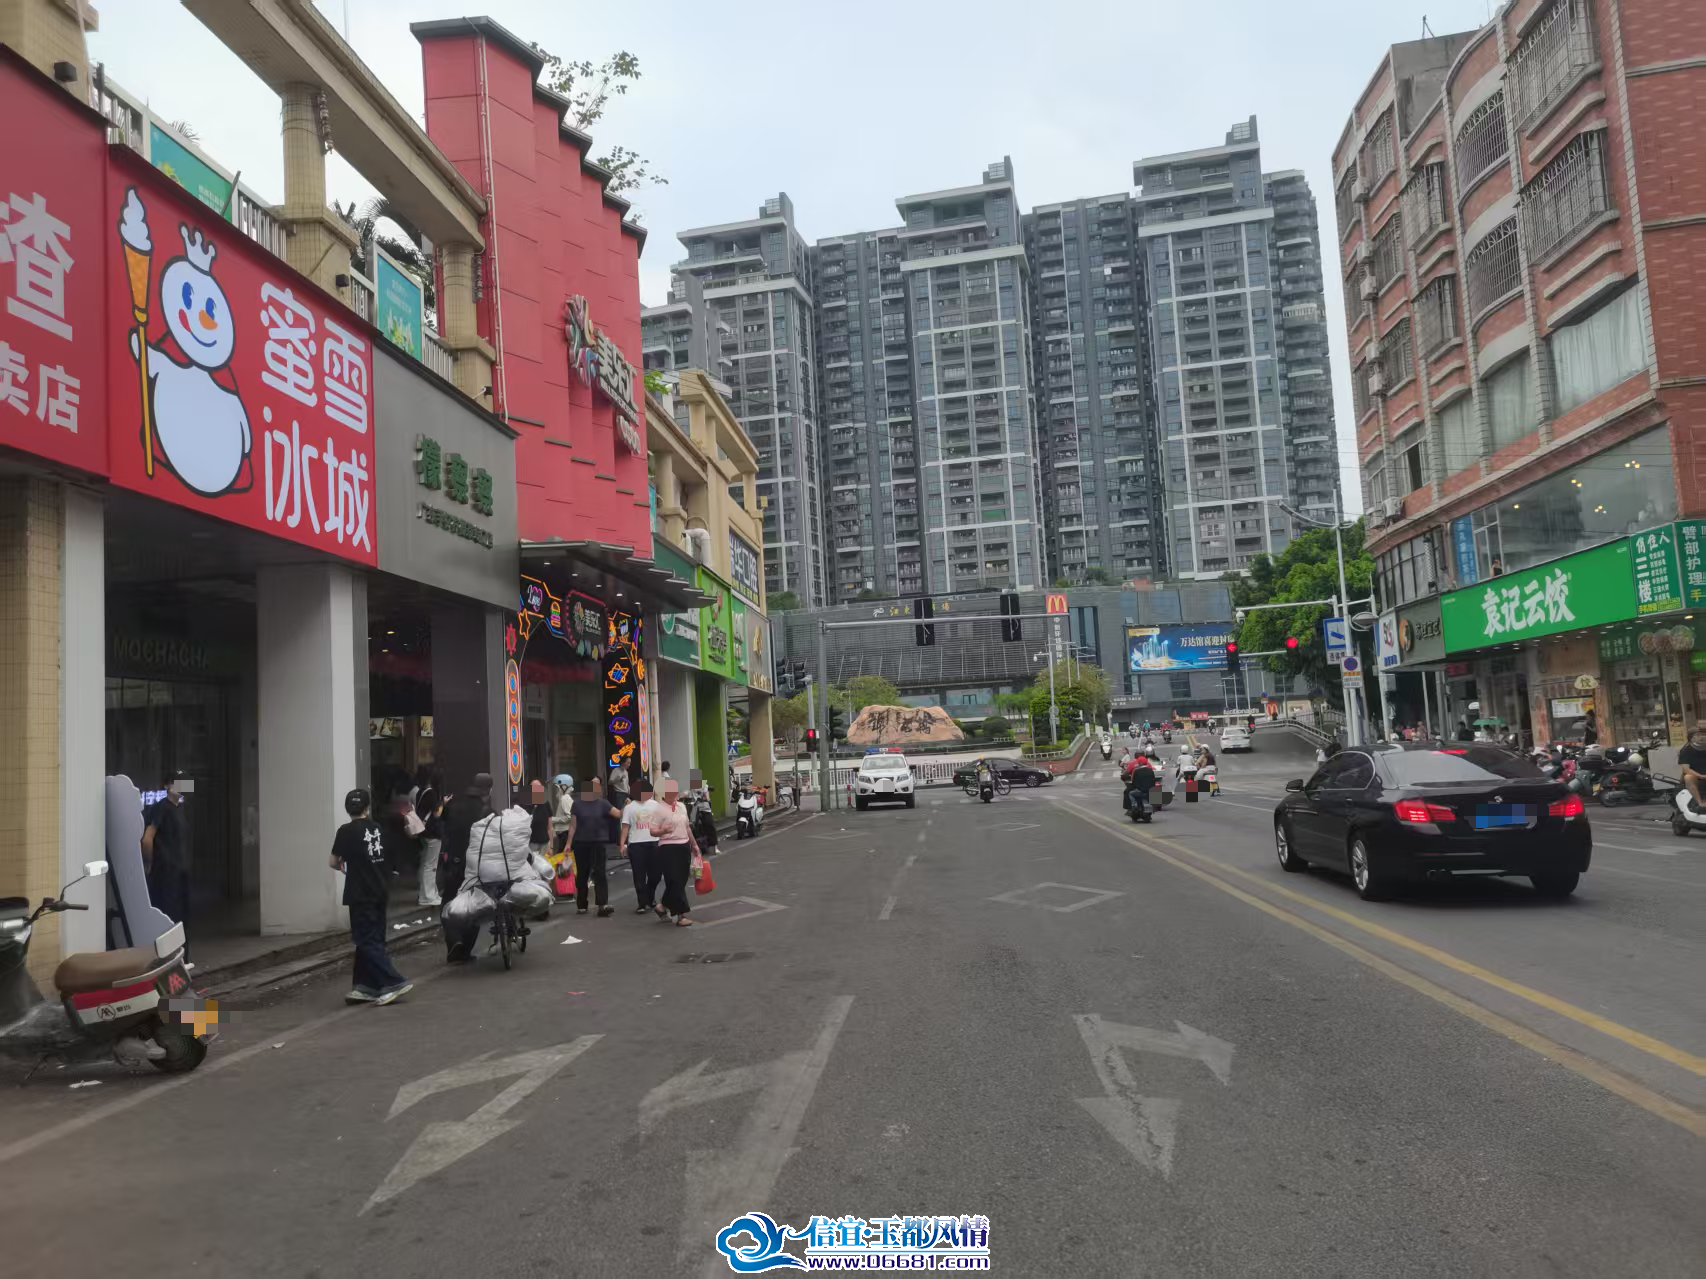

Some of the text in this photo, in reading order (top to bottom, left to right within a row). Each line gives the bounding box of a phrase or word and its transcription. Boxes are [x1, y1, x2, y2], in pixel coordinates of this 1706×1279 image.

[260, 281, 368, 435] 蜜雪
[261, 405, 371, 553] 冰城
[1481, 568, 1576, 638] 袁记云饺
